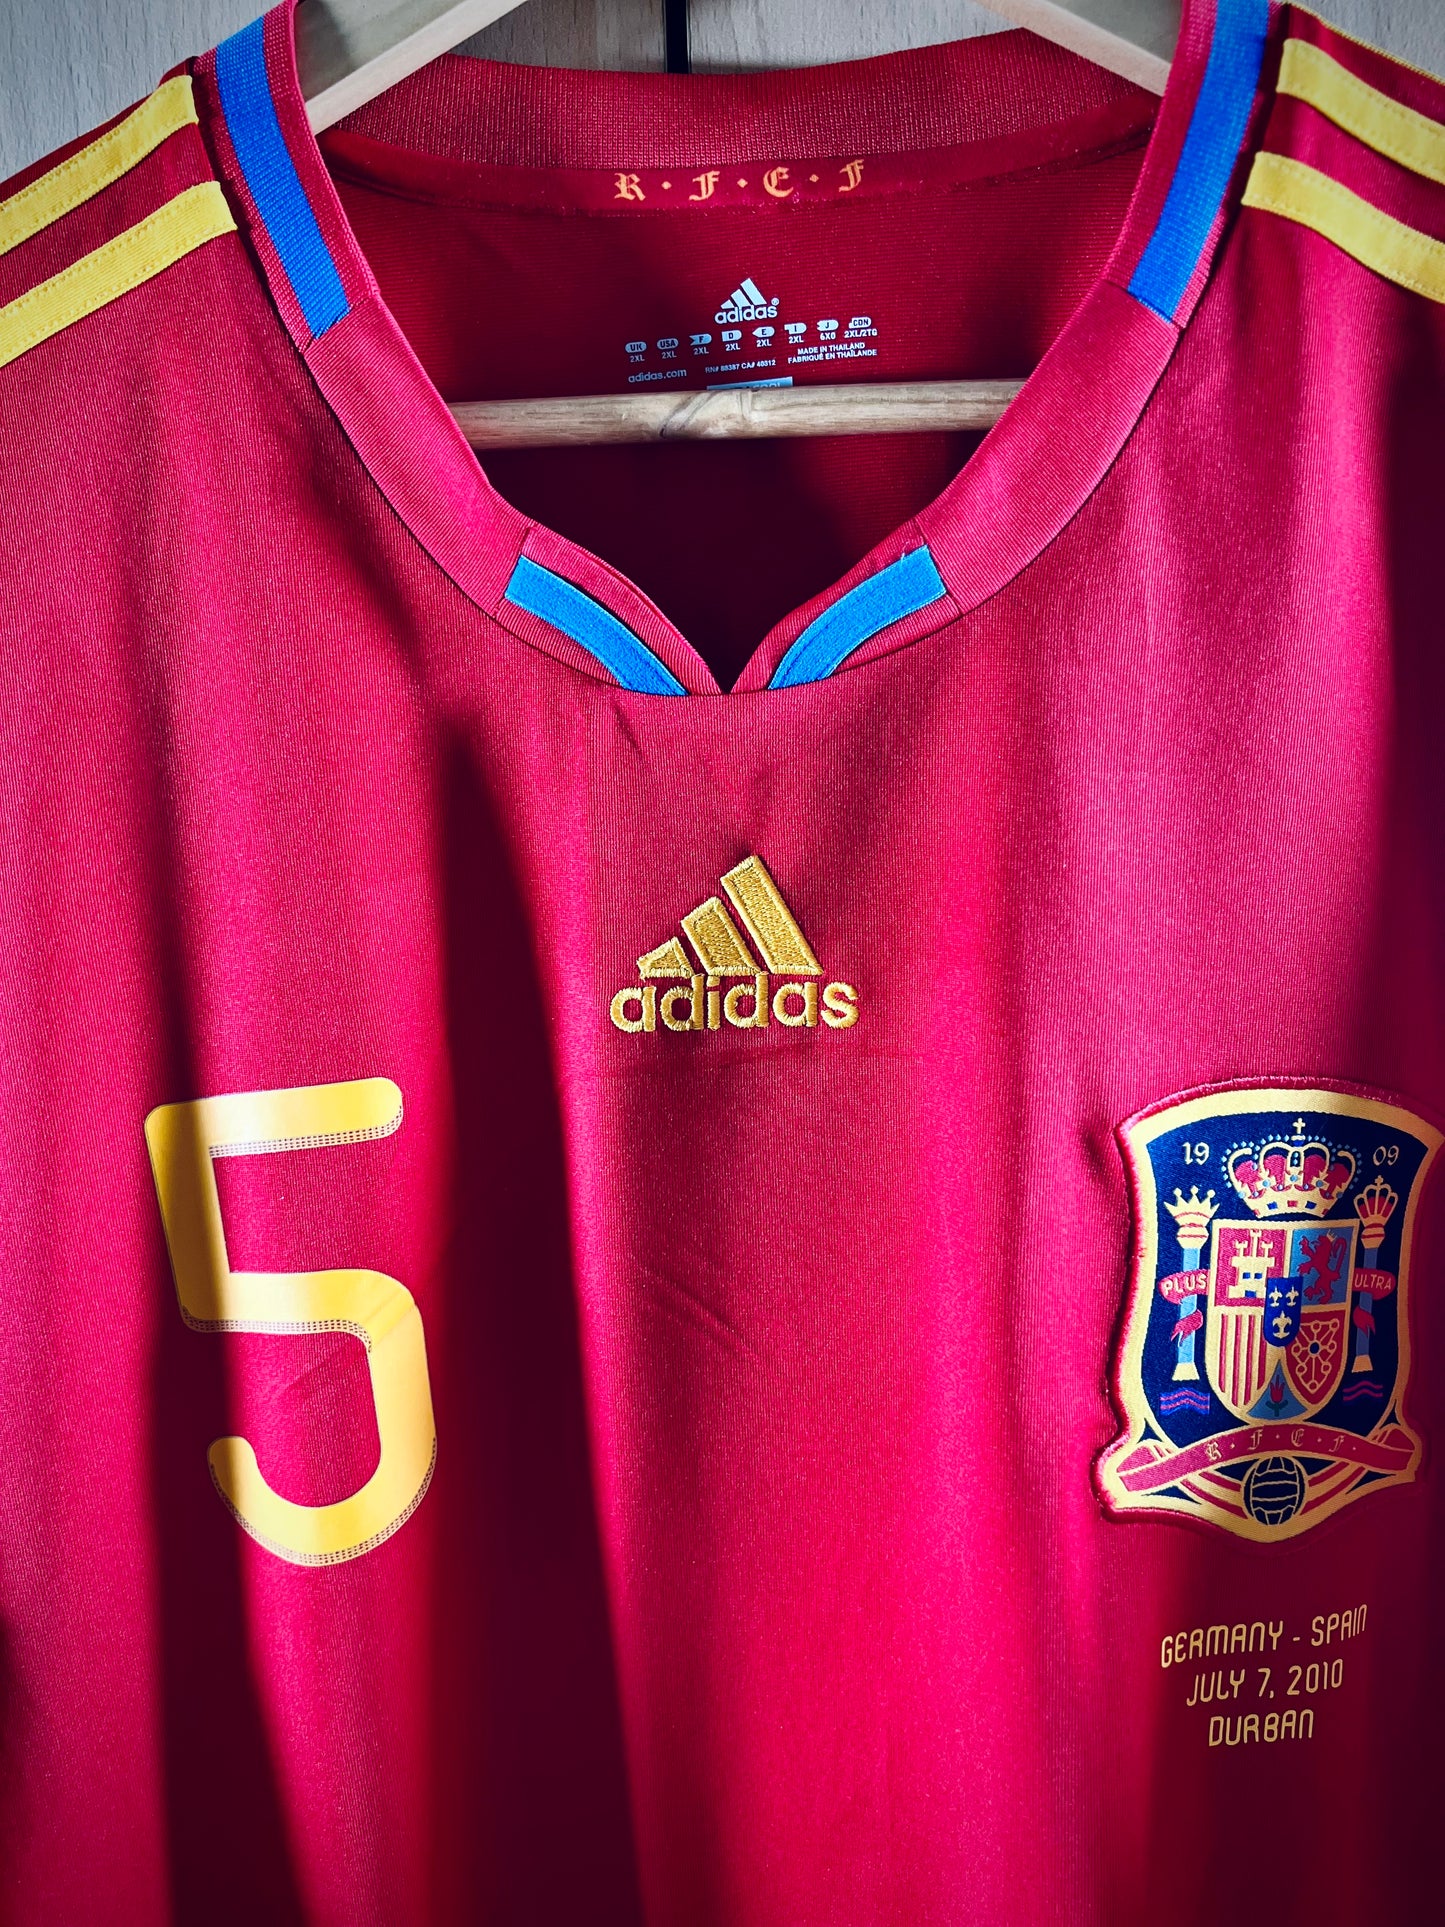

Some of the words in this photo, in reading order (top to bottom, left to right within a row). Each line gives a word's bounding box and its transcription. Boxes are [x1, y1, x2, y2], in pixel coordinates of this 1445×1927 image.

[714, 304, 778, 325] adidas
[629, 354, 645, 363] 2XL
[661, 350, 677, 359] 2XL
[693, 346, 710, 355] 2XL
[725, 343, 741, 352] 2XL
[756, 339, 772, 348] 2XL
[788, 335, 804, 344] 2XL
[660, 339, 676, 349] USA
[797, 346, 818, 355] MADE
[820, 345, 828, 353] IN
[829, 342, 866, 352] THAILAND
[825, 352, 836, 360] EN
[628, 368, 687, 383] adidas.com
[609, 971, 860, 1033] adidas
[1182, 1141, 1210, 1167] 19
[1373, 1144, 1400, 1167] 09
[1164, 1274, 1208, 1296] PLUS
[1353, 1274, 1392, 1292] ULTRA
[145, 1076, 438, 1567] 5
[1160, 1620, 1284, 1668] GERMANY
[1311, 1603, 1368, 1647] SPAIN
[1186, 1668, 1246, 1706] JULY
[1257, 1667, 1275, 1699] 7,
[1286, 1658, 1344, 1696] 2010
[1208, 1708, 1314, 1747] DURBAN
